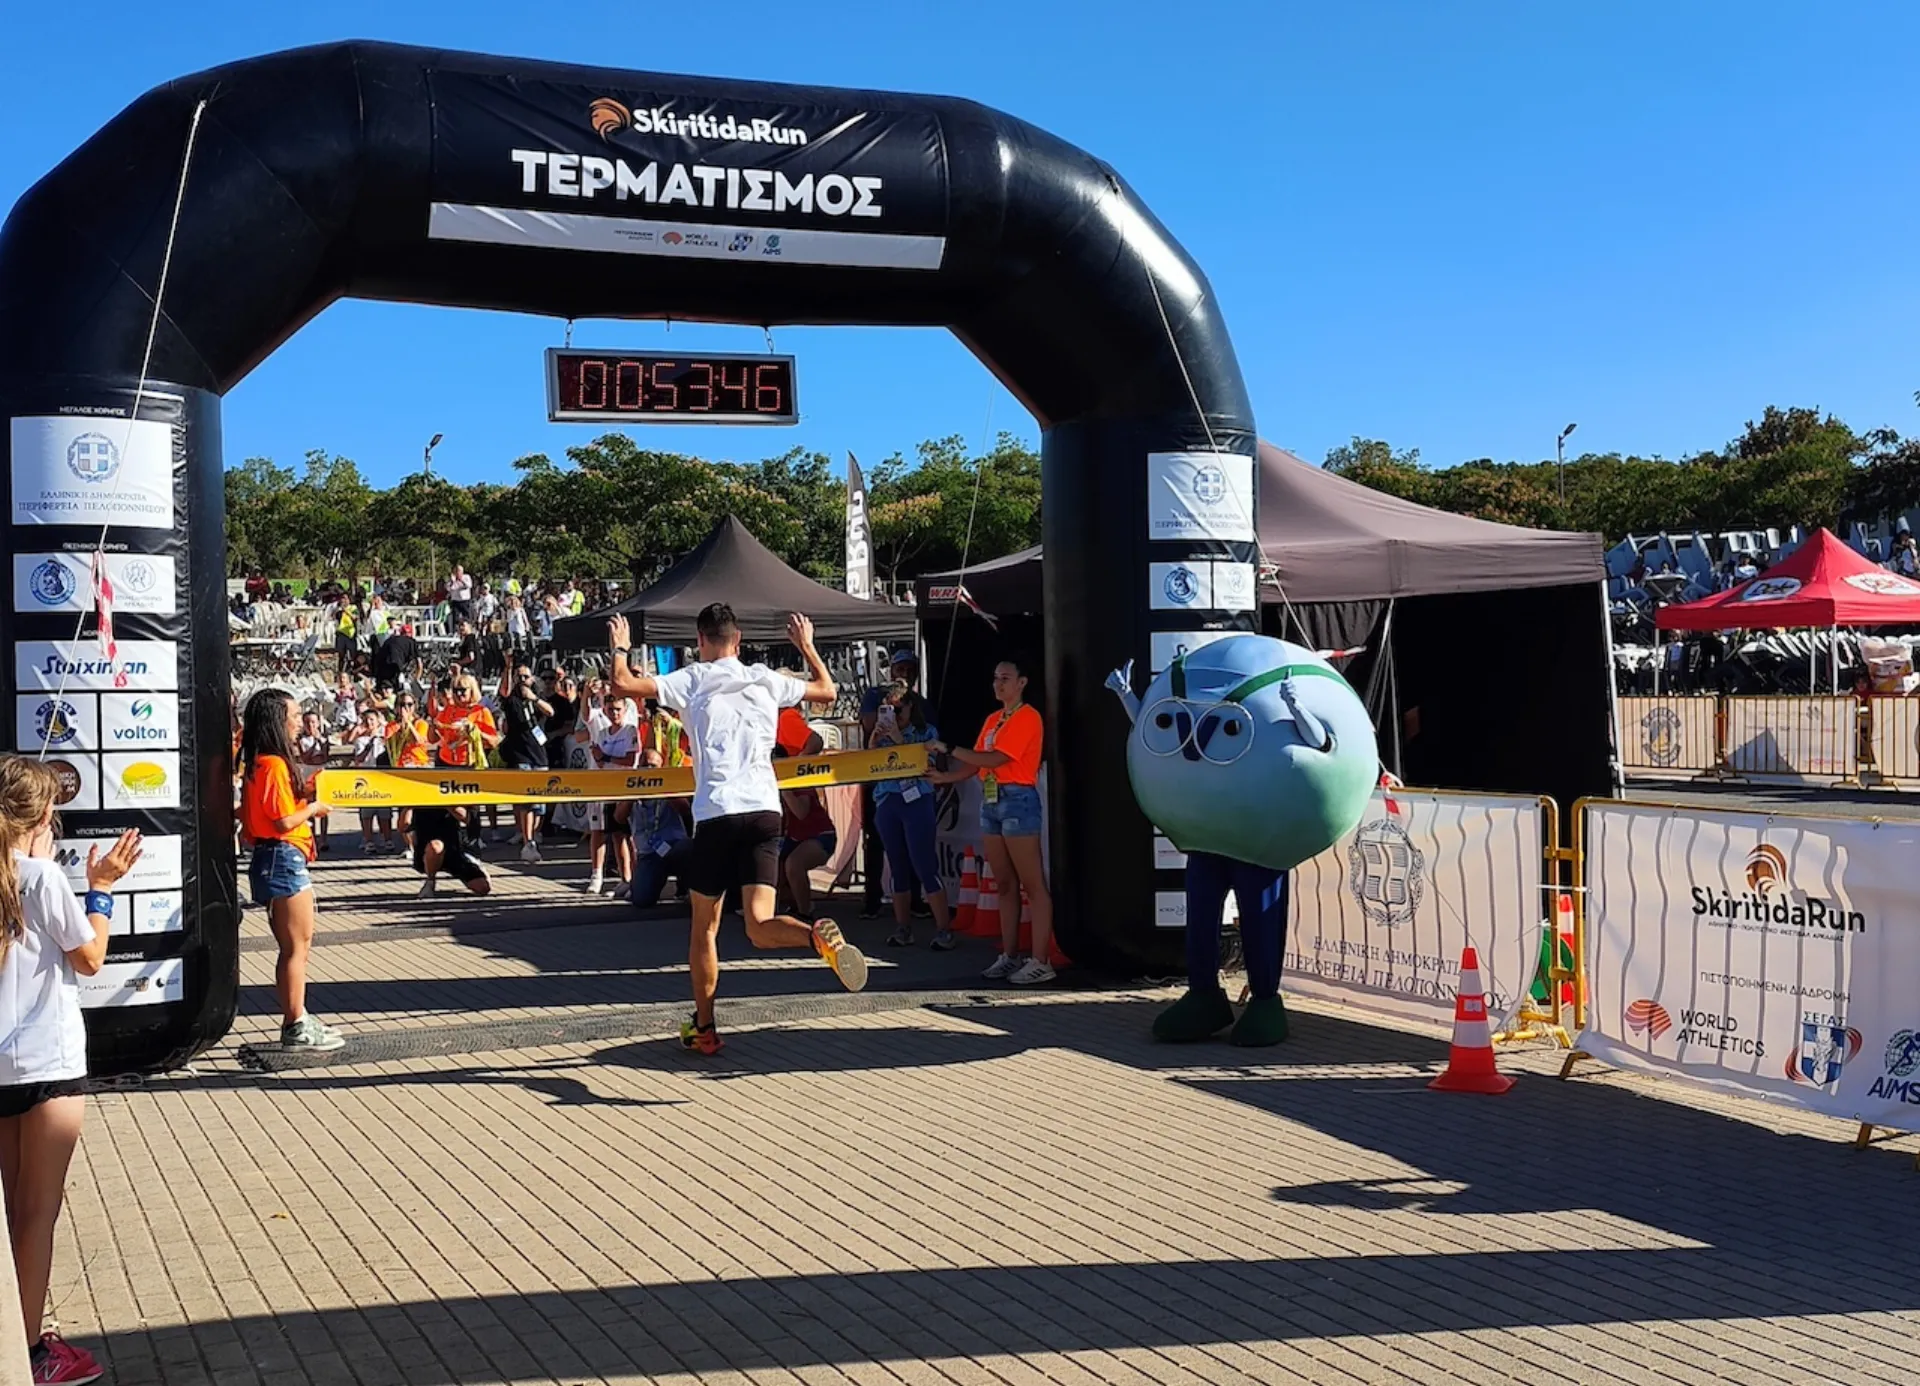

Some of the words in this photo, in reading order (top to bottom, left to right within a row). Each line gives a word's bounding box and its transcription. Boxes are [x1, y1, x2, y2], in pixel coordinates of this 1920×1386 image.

[633, 108, 808, 146] SkiritidaRun
[511, 149, 882, 217] ΤΕΡΜΑΤΙΣΜΟΣ
[19, 501, 79, 511] ΠΕΡΙΦΕΡΕΙΑ
[40, 490, 88, 500] ΕΛΛΗΝΙΚΗ
[113, 725, 168, 739] volton
[796, 762, 831, 776] 5km
[332, 788, 392, 800] SkiritidaRun
[439, 781, 479, 794] 5km
[626, 776, 663, 788] 5km
[1691, 886, 1866, 933] SkiritidaRun
[1285, 951, 1366, 985] ΠΕΡΙΦΕΡΕΙΑ
[1313, 935, 1380, 962] ΕΛΛΗΝΙΚΗ
[1382, 949, 1461, 977] ΔΗΜΟΚΡΑΤΙ
[1700, 971, 1788, 994] ΠΙΣΤΟΠΟΙΗΜΕΝΗ
[1789, 984, 1851, 1003] ΔΙΑΔΡΟΜΗ
[1680, 1008, 1738, 1032] WORLD
[1803, 1010, 1846, 1027] ΣΕΓΑΣ
[1866, 1076, 1920, 1105] AIMS
